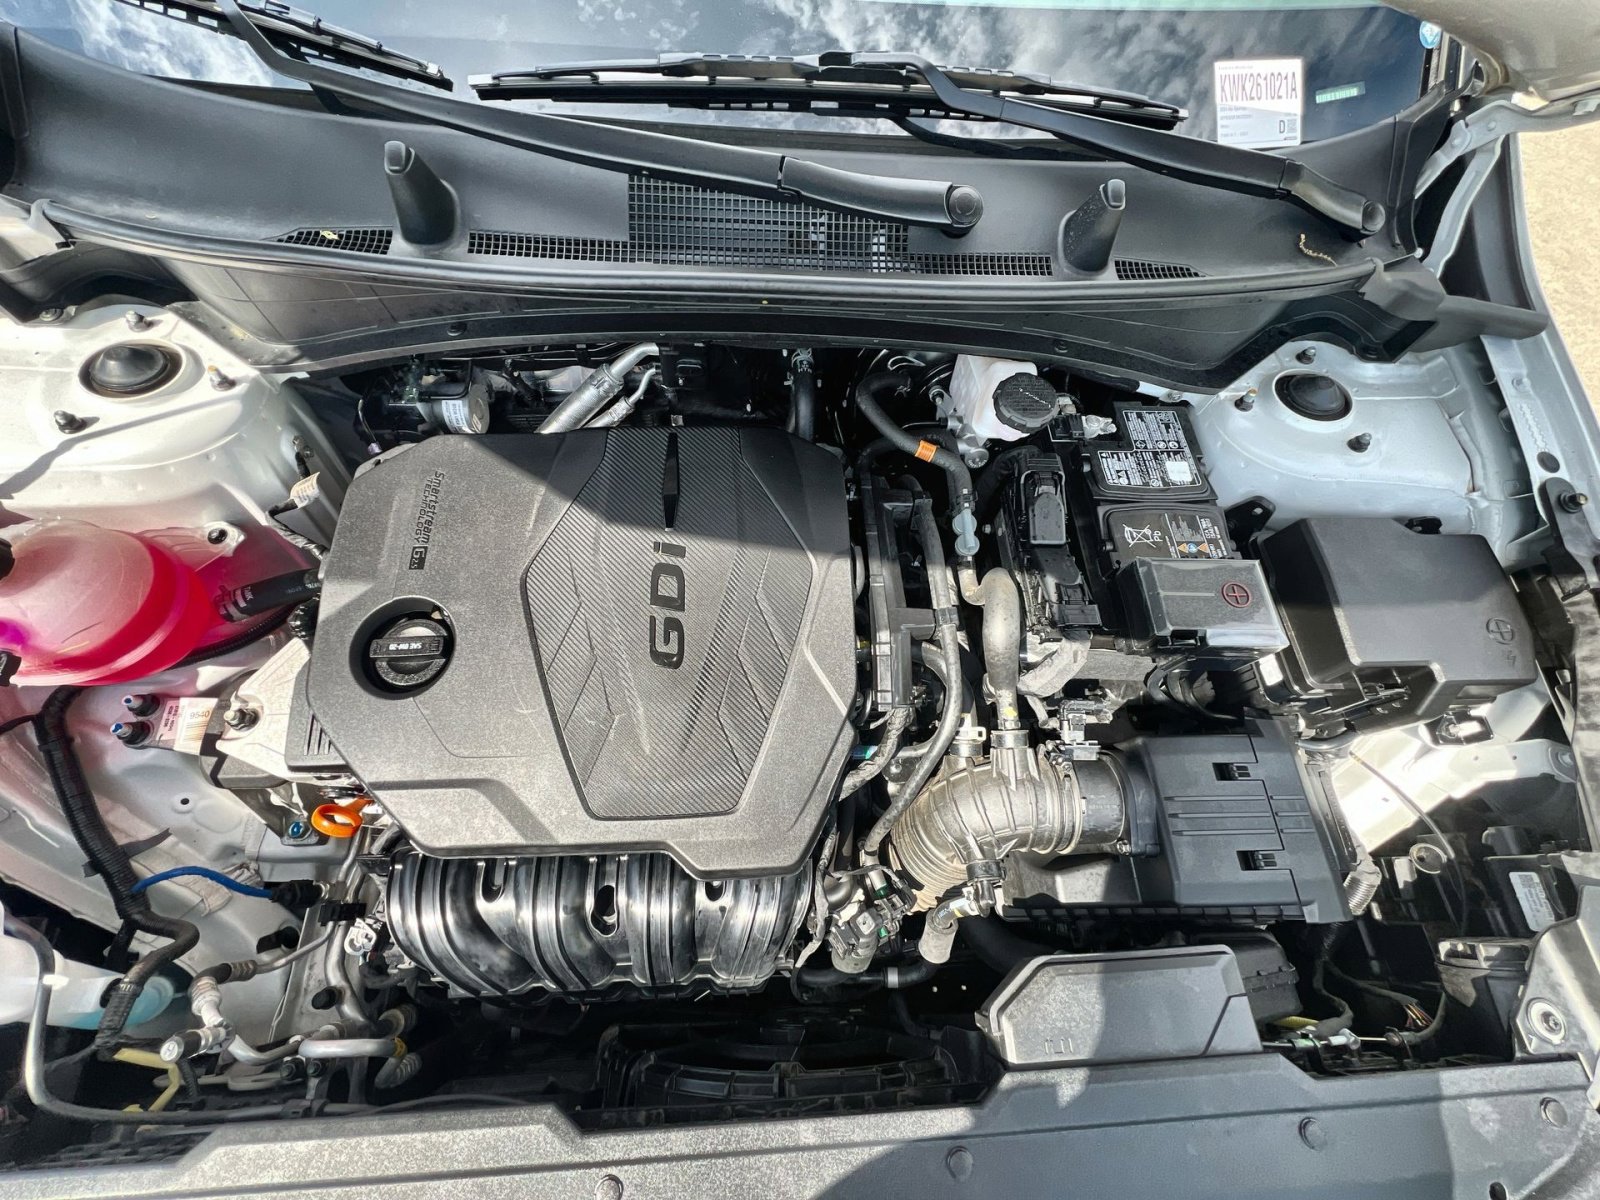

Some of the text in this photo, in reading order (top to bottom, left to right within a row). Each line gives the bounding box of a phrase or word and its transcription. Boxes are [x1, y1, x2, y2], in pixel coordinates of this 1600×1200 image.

[1220, 72, 1298, 102] KWK261021A
[1279, 120, 1286, 134] D
[414, 478, 433, 544] TECHNOLOGY
[422, 470, 445, 545] Smartstream
[1153, 530, 1163, 542] Pb
[649, 541, 686, 669] GDi
[189, 710, 210, 719] 9540
